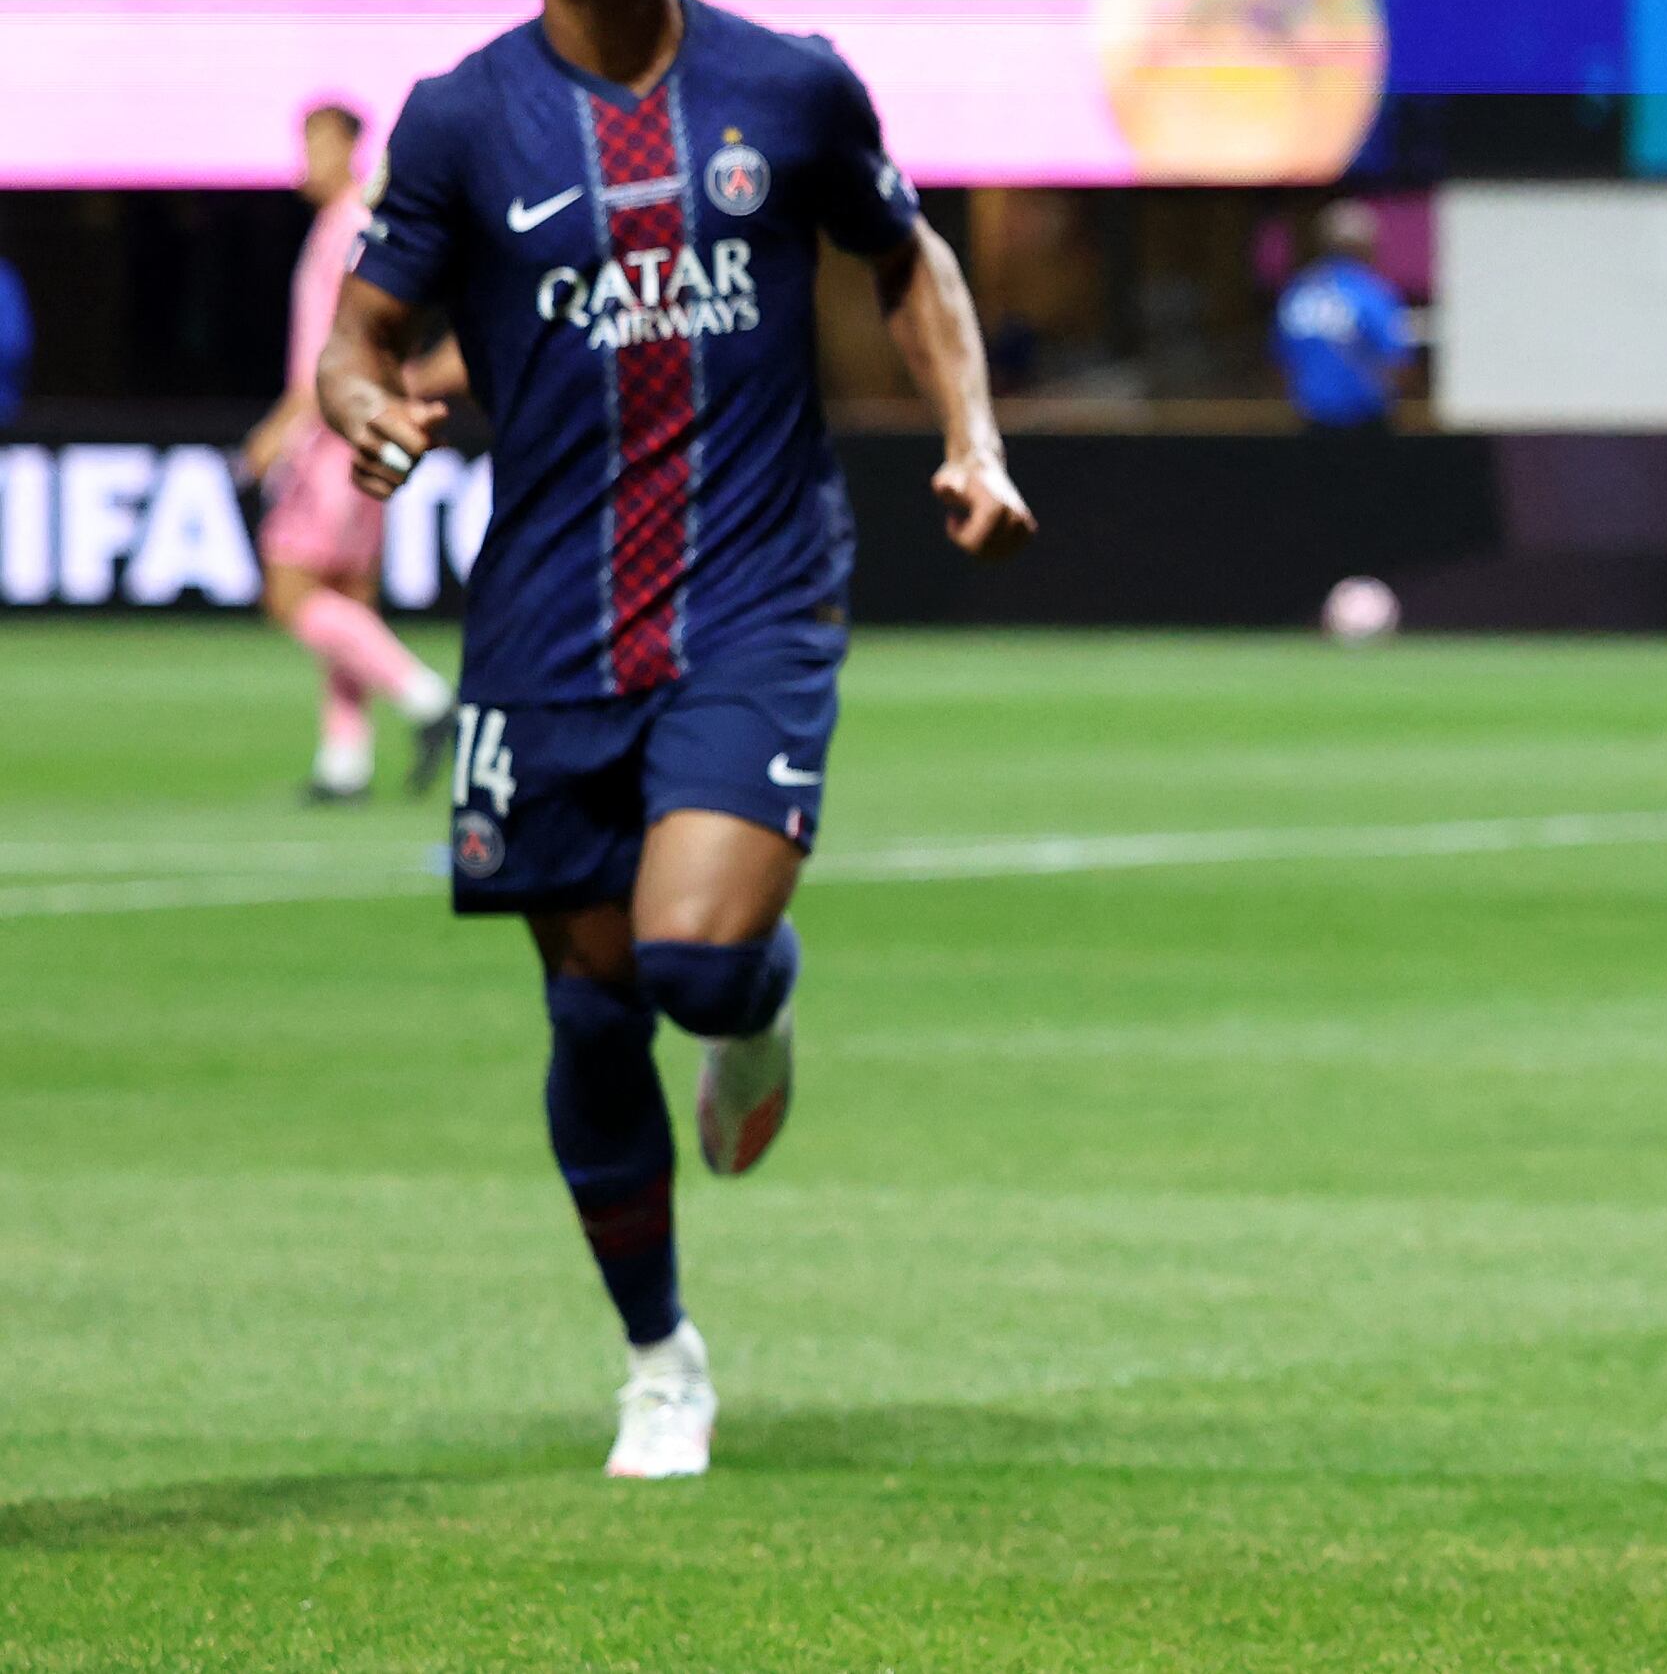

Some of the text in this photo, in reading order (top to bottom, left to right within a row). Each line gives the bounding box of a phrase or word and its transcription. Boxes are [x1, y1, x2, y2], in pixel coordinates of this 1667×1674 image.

[537, 237, 757, 329] QATAR
[586, 293, 761, 350] AIRWAYS
[0, 442, 261, 606] IFA
[453, 702, 516, 817] 14
